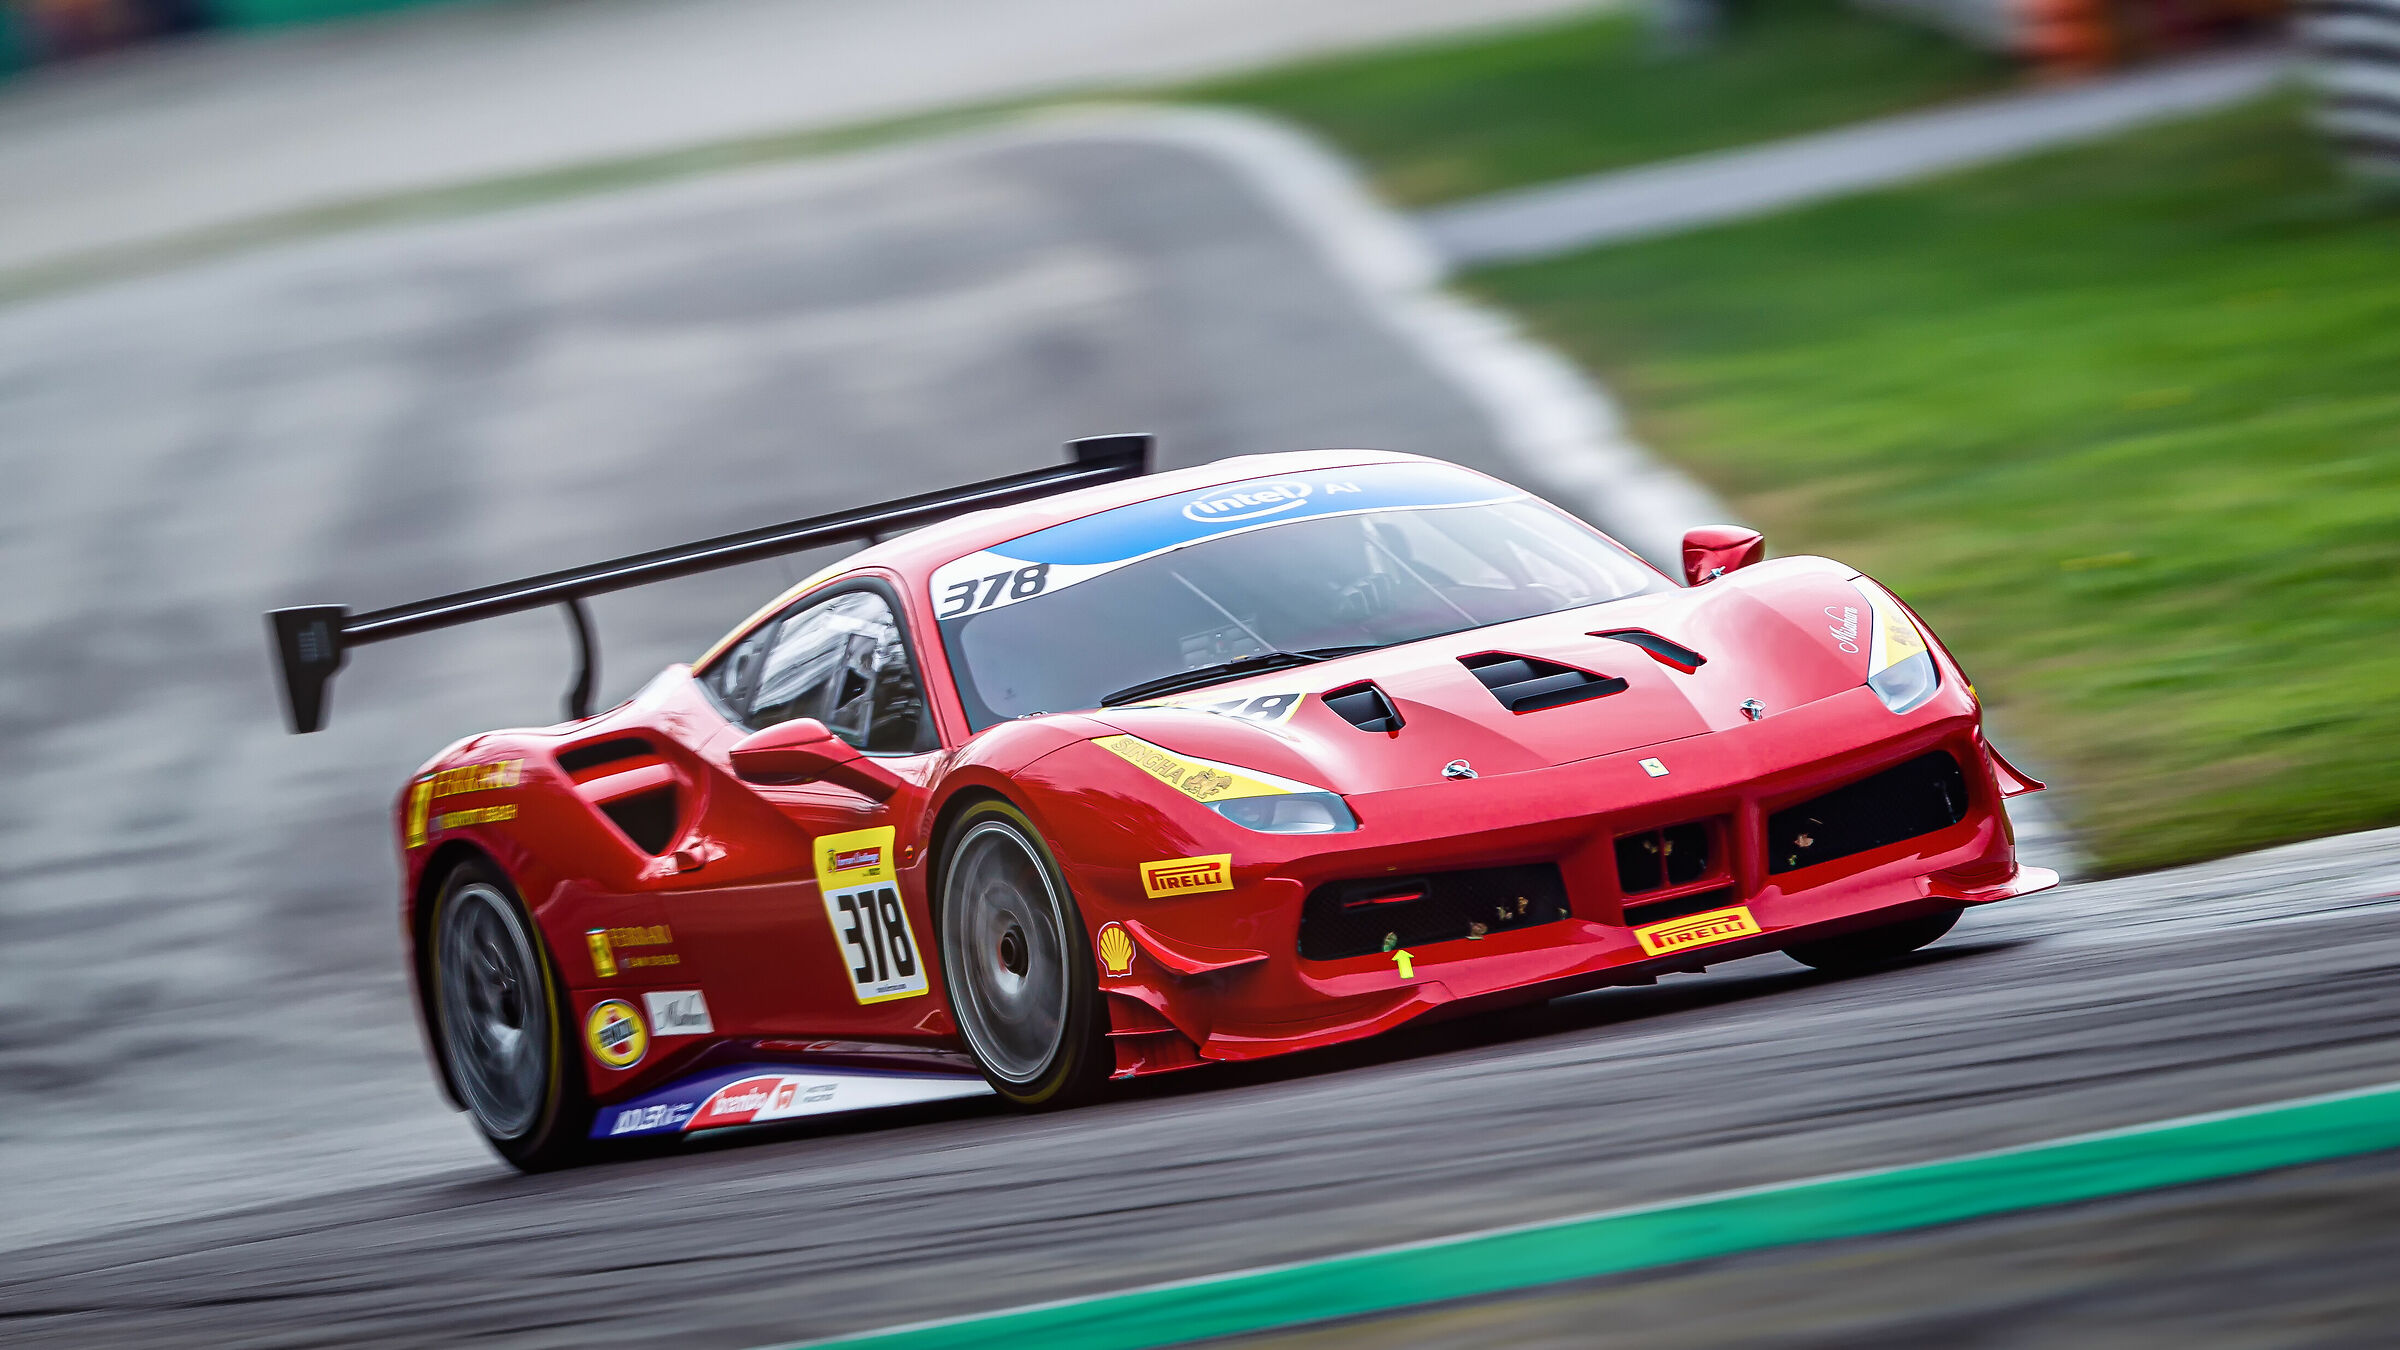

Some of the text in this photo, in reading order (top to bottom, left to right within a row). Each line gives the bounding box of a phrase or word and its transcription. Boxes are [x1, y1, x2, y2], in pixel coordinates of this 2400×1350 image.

[1195, 481, 1362, 514] intel AI
[940, 562, 1049, 619] 378
[1111, 737, 1186, 785] SINGHA
[1148, 862, 1222, 891] PIRELLI
[837, 887, 916, 984] 378
[1648, 914, 1746, 949] PIRELLI
